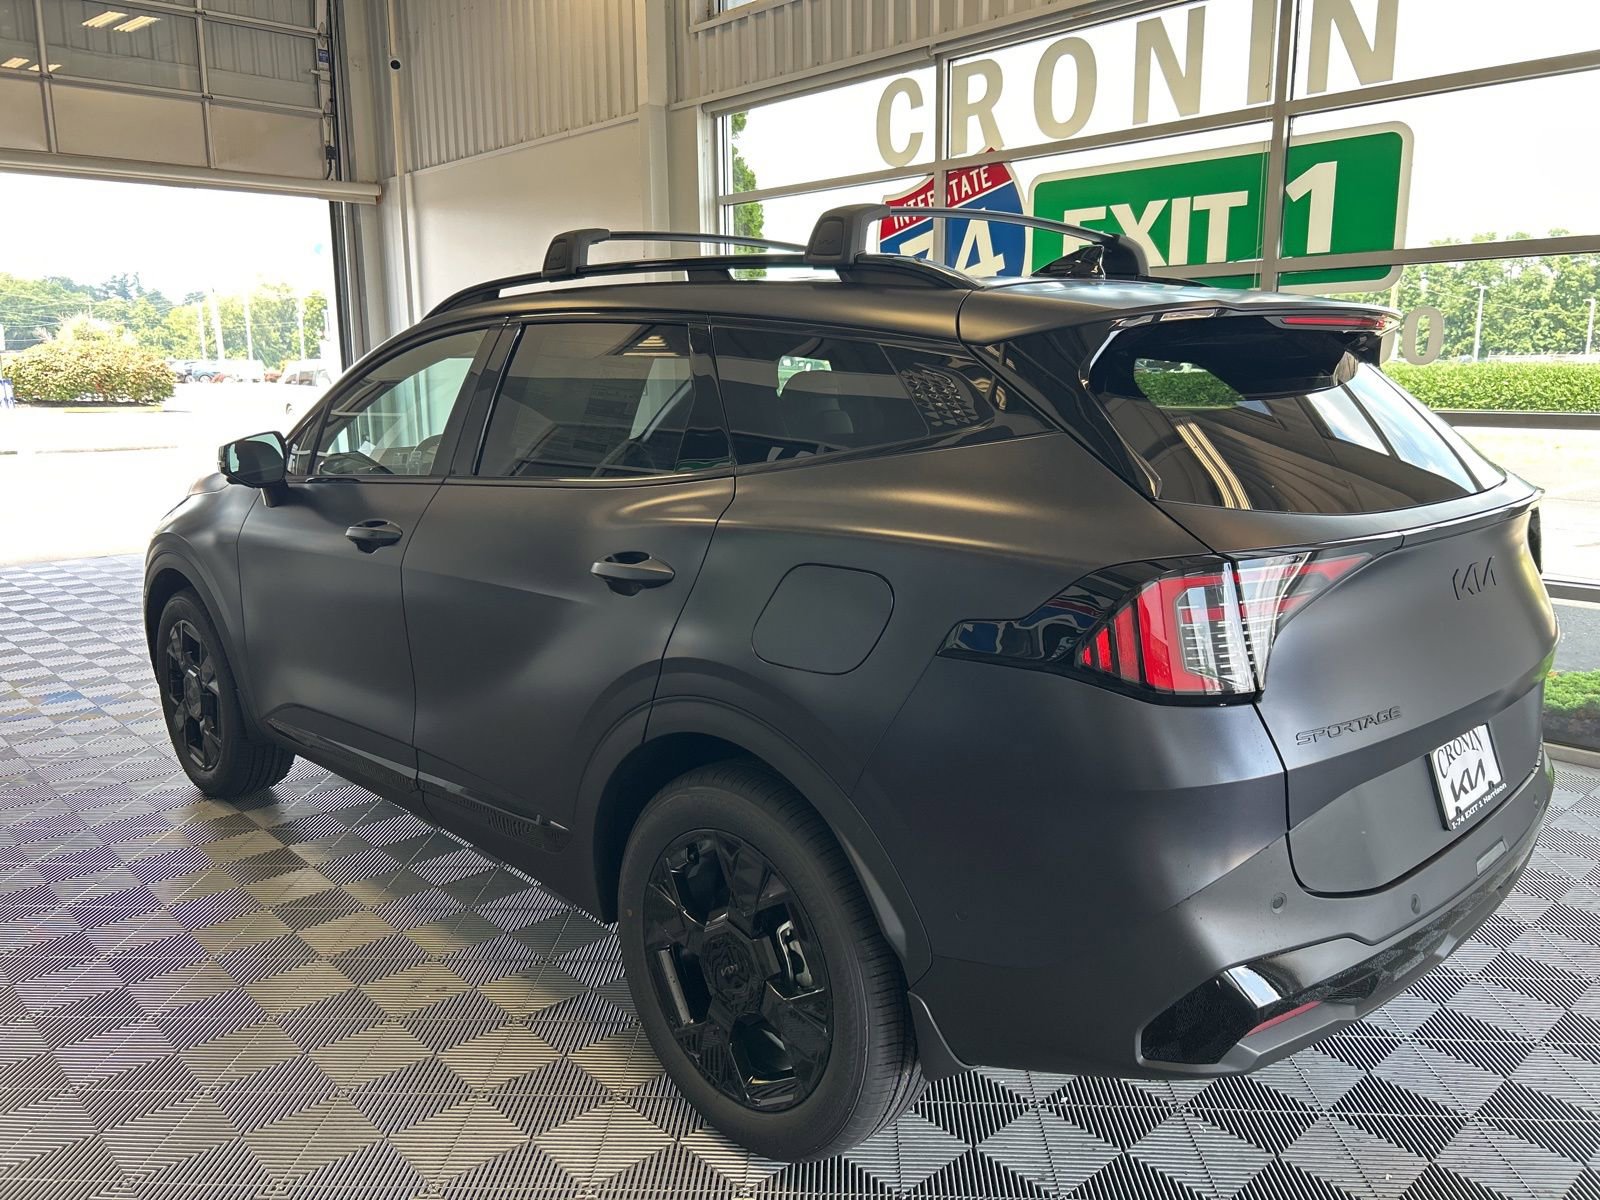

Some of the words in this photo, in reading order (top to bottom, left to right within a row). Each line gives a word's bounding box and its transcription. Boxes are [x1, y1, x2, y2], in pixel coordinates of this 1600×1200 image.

[876, 0, 1399, 167] CRONIN
[893, 165, 992, 230] INTERTATE
[1063, 190, 1249, 267] EXIT
[1285, 161, 1338, 254] 1
[1295, 705, 1402, 746] SPORTAGE
[1437, 727, 1485, 779] CRONIN
[1450, 758, 1486, 803] KIA
[1451, 814, 1466, 830] I-74
[1464, 803, 1479, 819] EXIT
